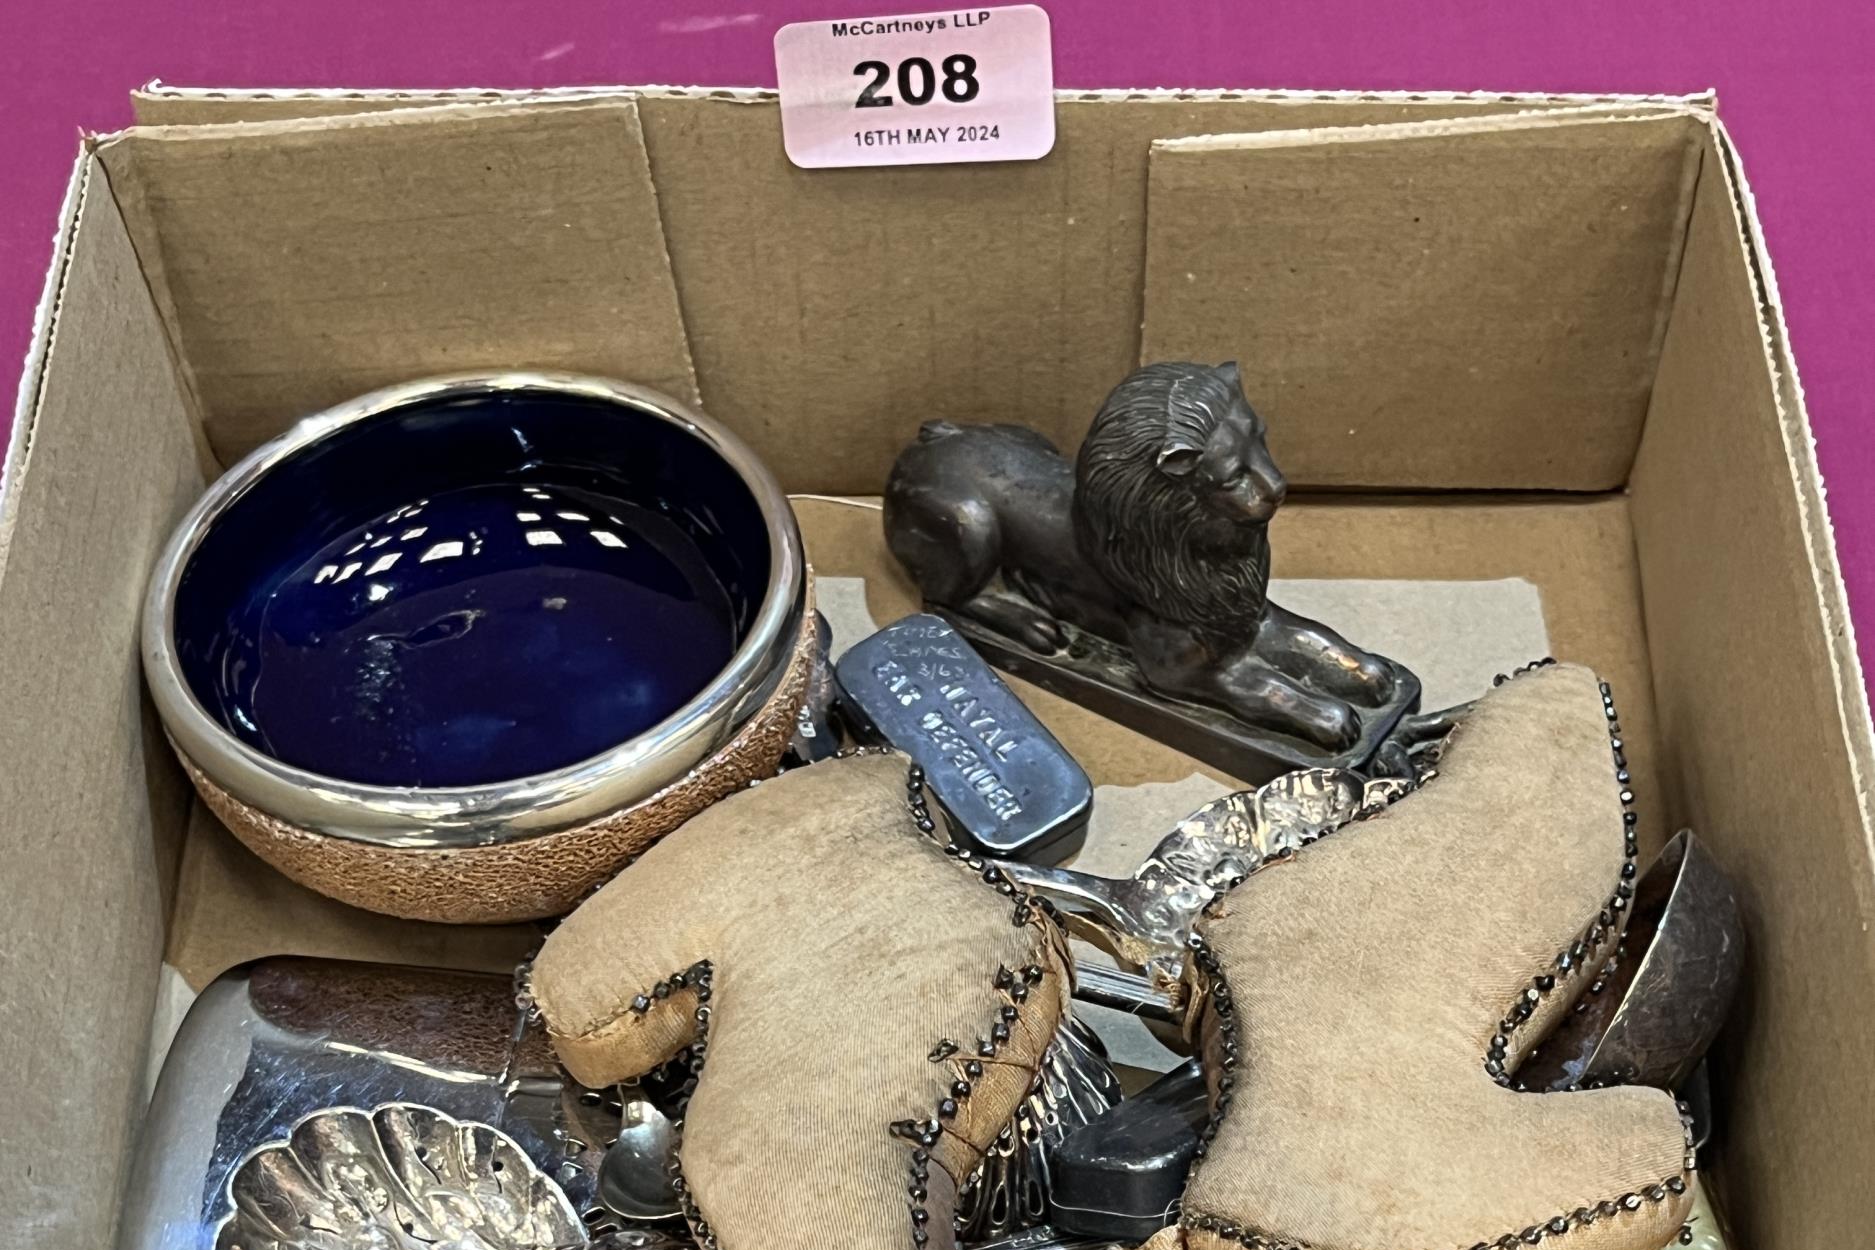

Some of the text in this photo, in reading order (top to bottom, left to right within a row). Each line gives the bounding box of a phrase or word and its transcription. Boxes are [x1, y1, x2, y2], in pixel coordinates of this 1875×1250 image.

[831, 11, 991, 37] McCartneys LLP
[853, 54, 980, 108] 208
[854, 125, 1000, 146] 16TH MAY 2024
[939, 684, 1018, 763] NAVAL
[919, 710, 1022, 822] DEFENDER
